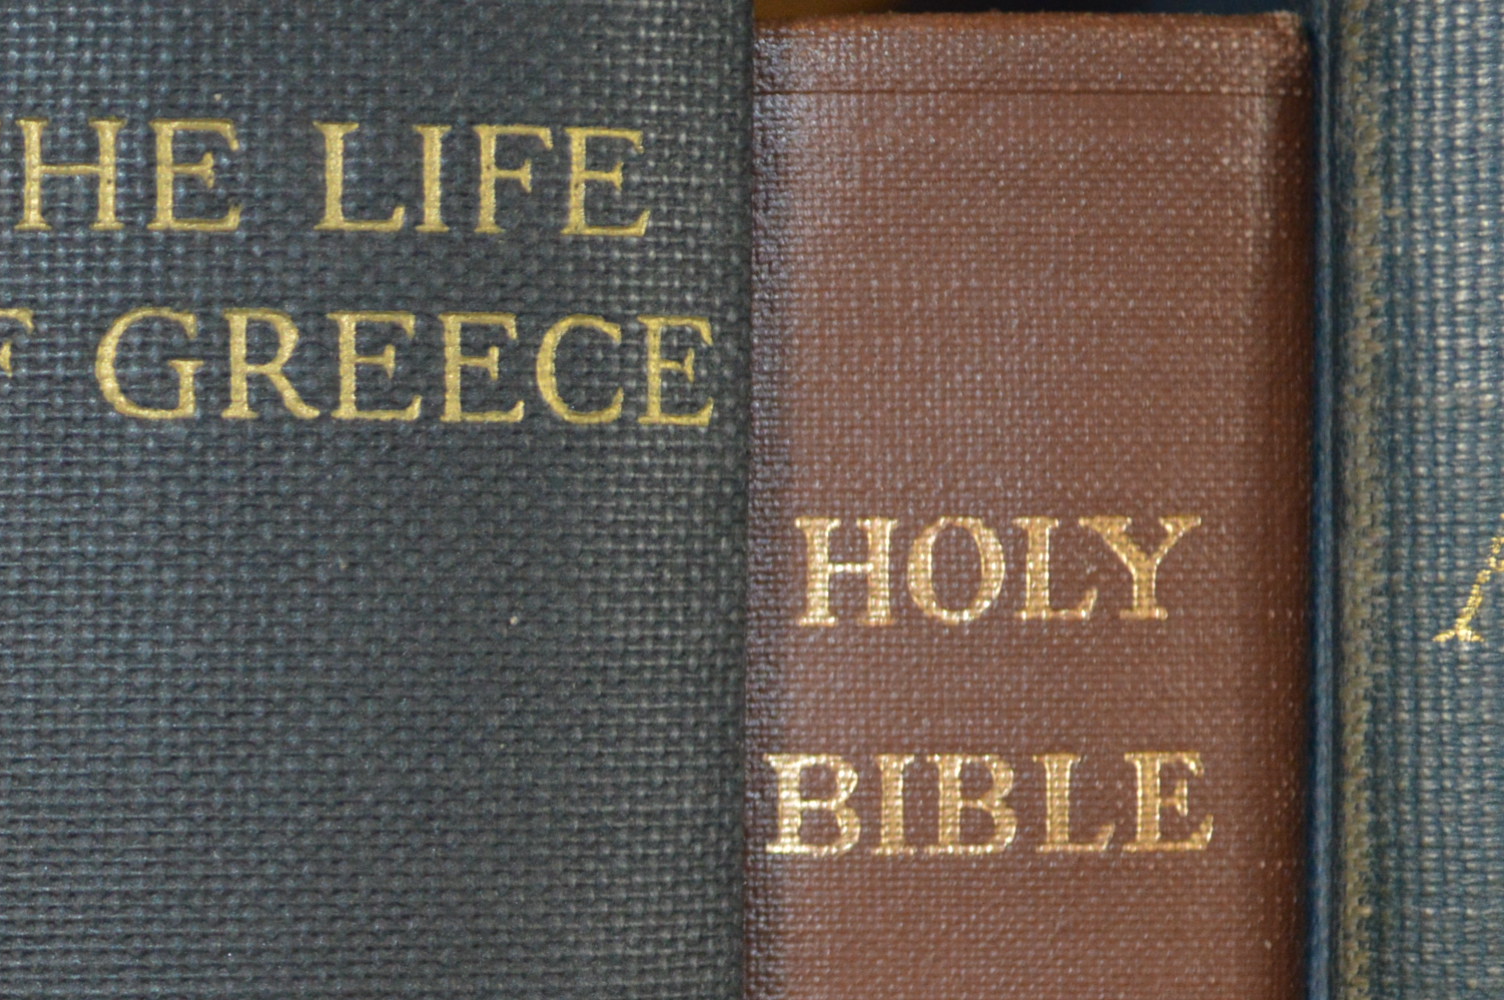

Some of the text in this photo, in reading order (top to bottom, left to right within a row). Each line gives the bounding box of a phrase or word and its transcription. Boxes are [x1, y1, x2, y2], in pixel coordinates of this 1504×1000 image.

[313, 120, 652, 236] LIFE
[95, 306, 715, 428] GREECE
[795, 515, 1202, 627] HOLY
[763, 751, 1214, 856] BIBLE
